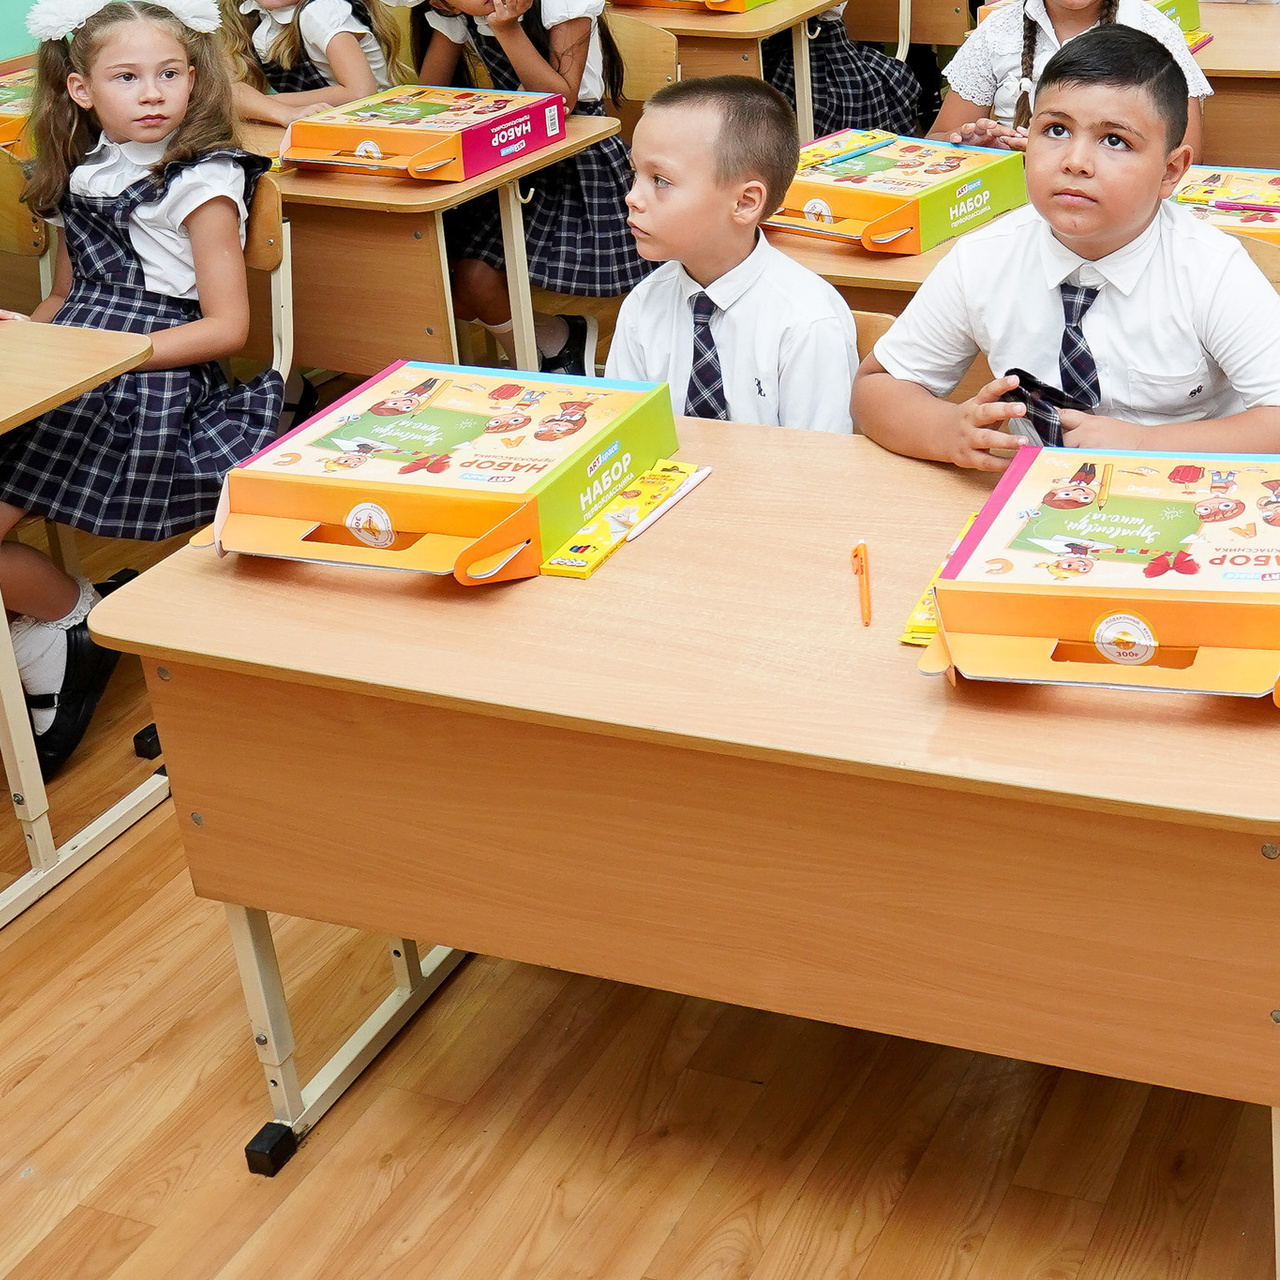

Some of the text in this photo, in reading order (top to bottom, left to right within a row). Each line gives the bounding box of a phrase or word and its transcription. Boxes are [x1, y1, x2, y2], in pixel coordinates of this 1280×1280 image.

[491, 121, 532, 147] НАБОР
[949, 190, 990, 221] НАБОР
[459, 458, 548, 474] НАБОР
[580, 452, 631, 511] НАБОР
[583, 472, 634, 522] ПЕРВОКЛАССНИКА
